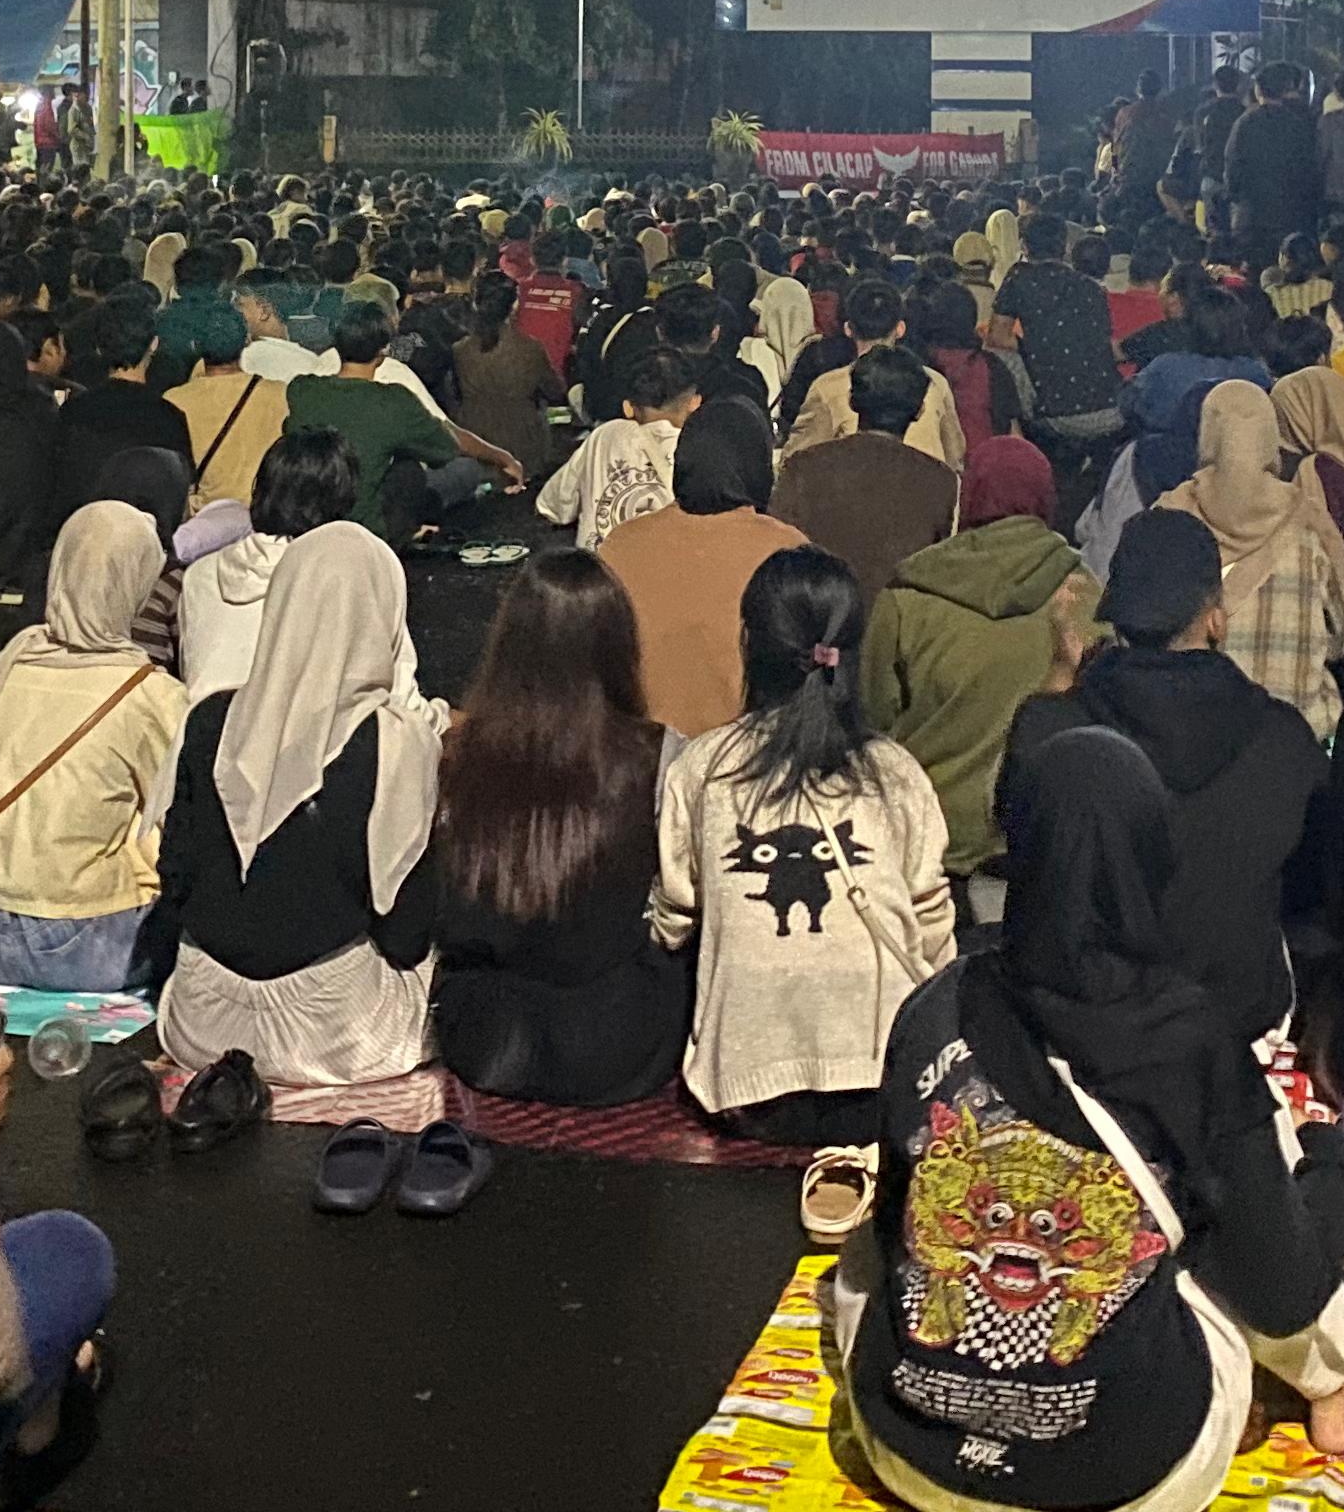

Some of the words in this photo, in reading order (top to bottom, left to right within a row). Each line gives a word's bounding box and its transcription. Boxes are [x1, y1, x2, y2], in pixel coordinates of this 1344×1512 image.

[764, 149, 810, 177] FROM
[811, 151, 873, 179] CILACAP
[922, 150, 946, 177] FOR
